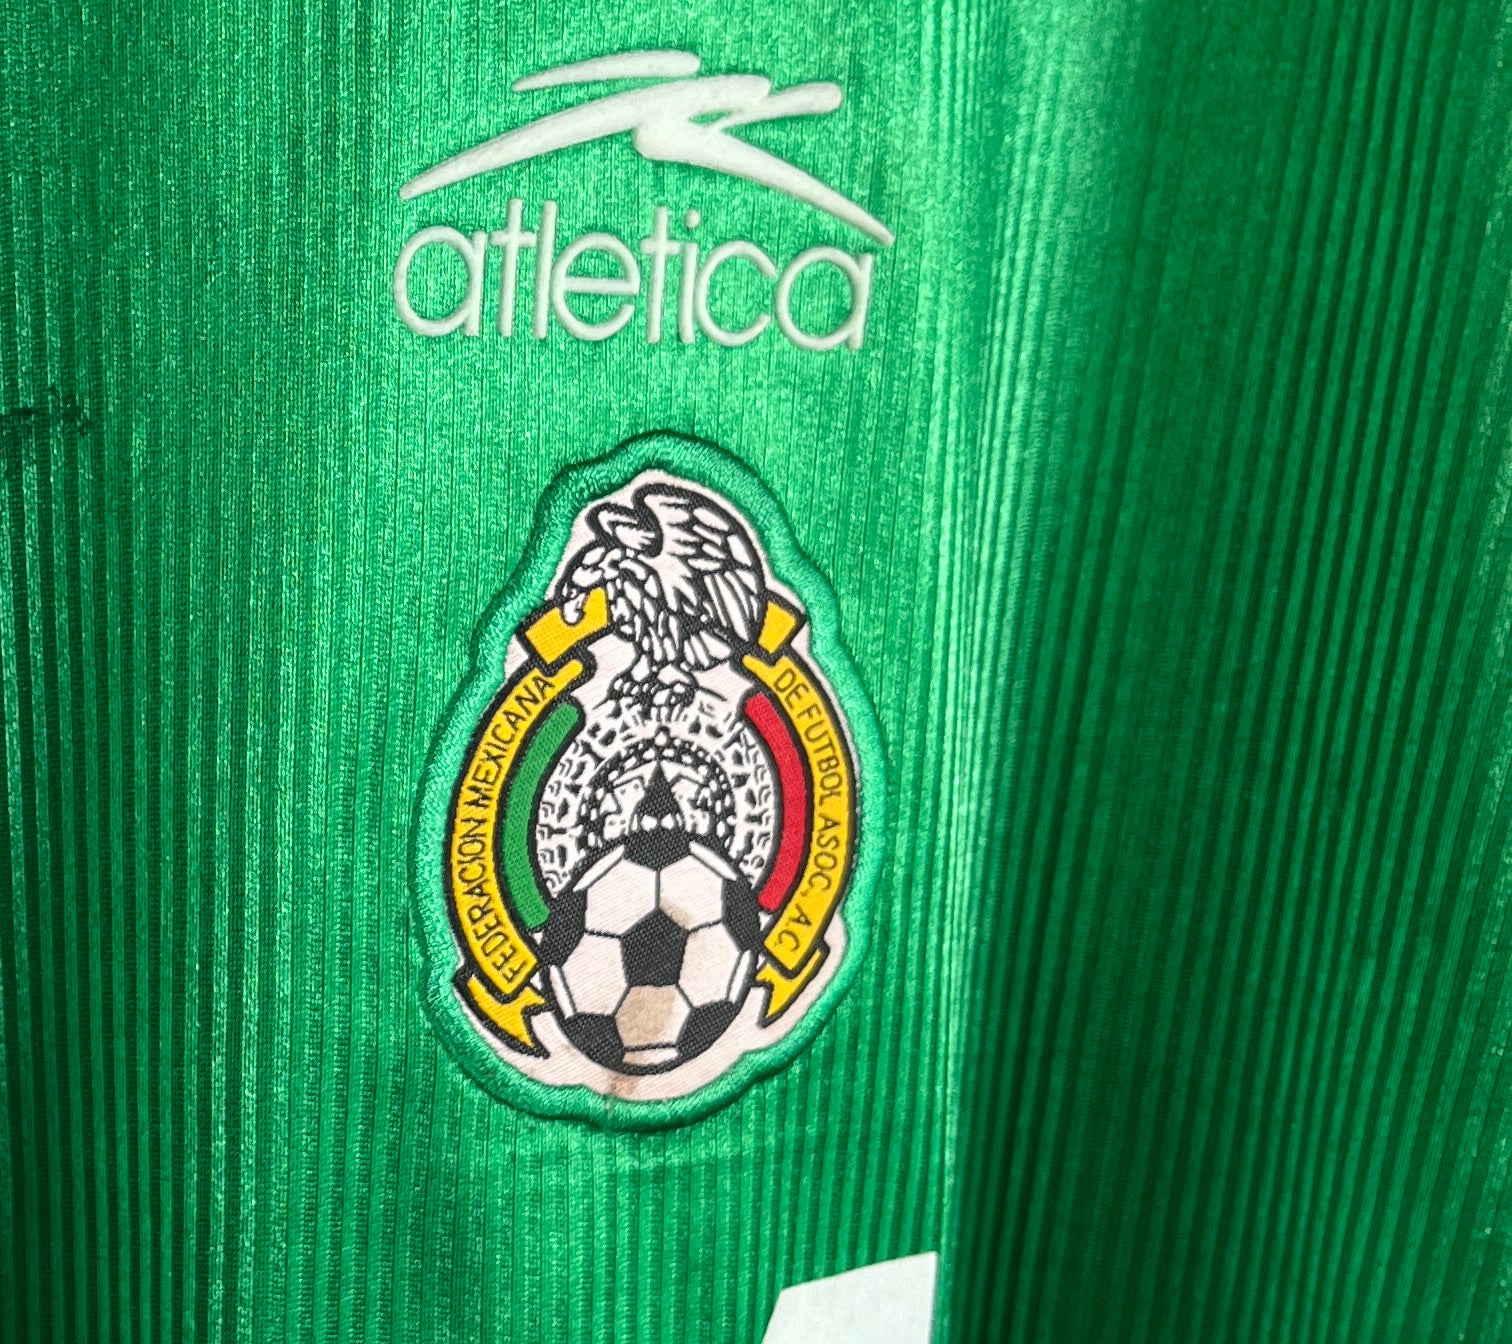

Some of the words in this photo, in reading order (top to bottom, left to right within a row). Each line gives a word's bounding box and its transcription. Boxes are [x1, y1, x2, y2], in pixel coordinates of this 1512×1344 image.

[393, 199, 874, 353] atletica
[464, 674, 555, 809] MEXICANA
[773, 668, 810, 709] DE
[797, 703, 843, 807] FUTBOL
[457, 817, 529, 984] FEDERACION
